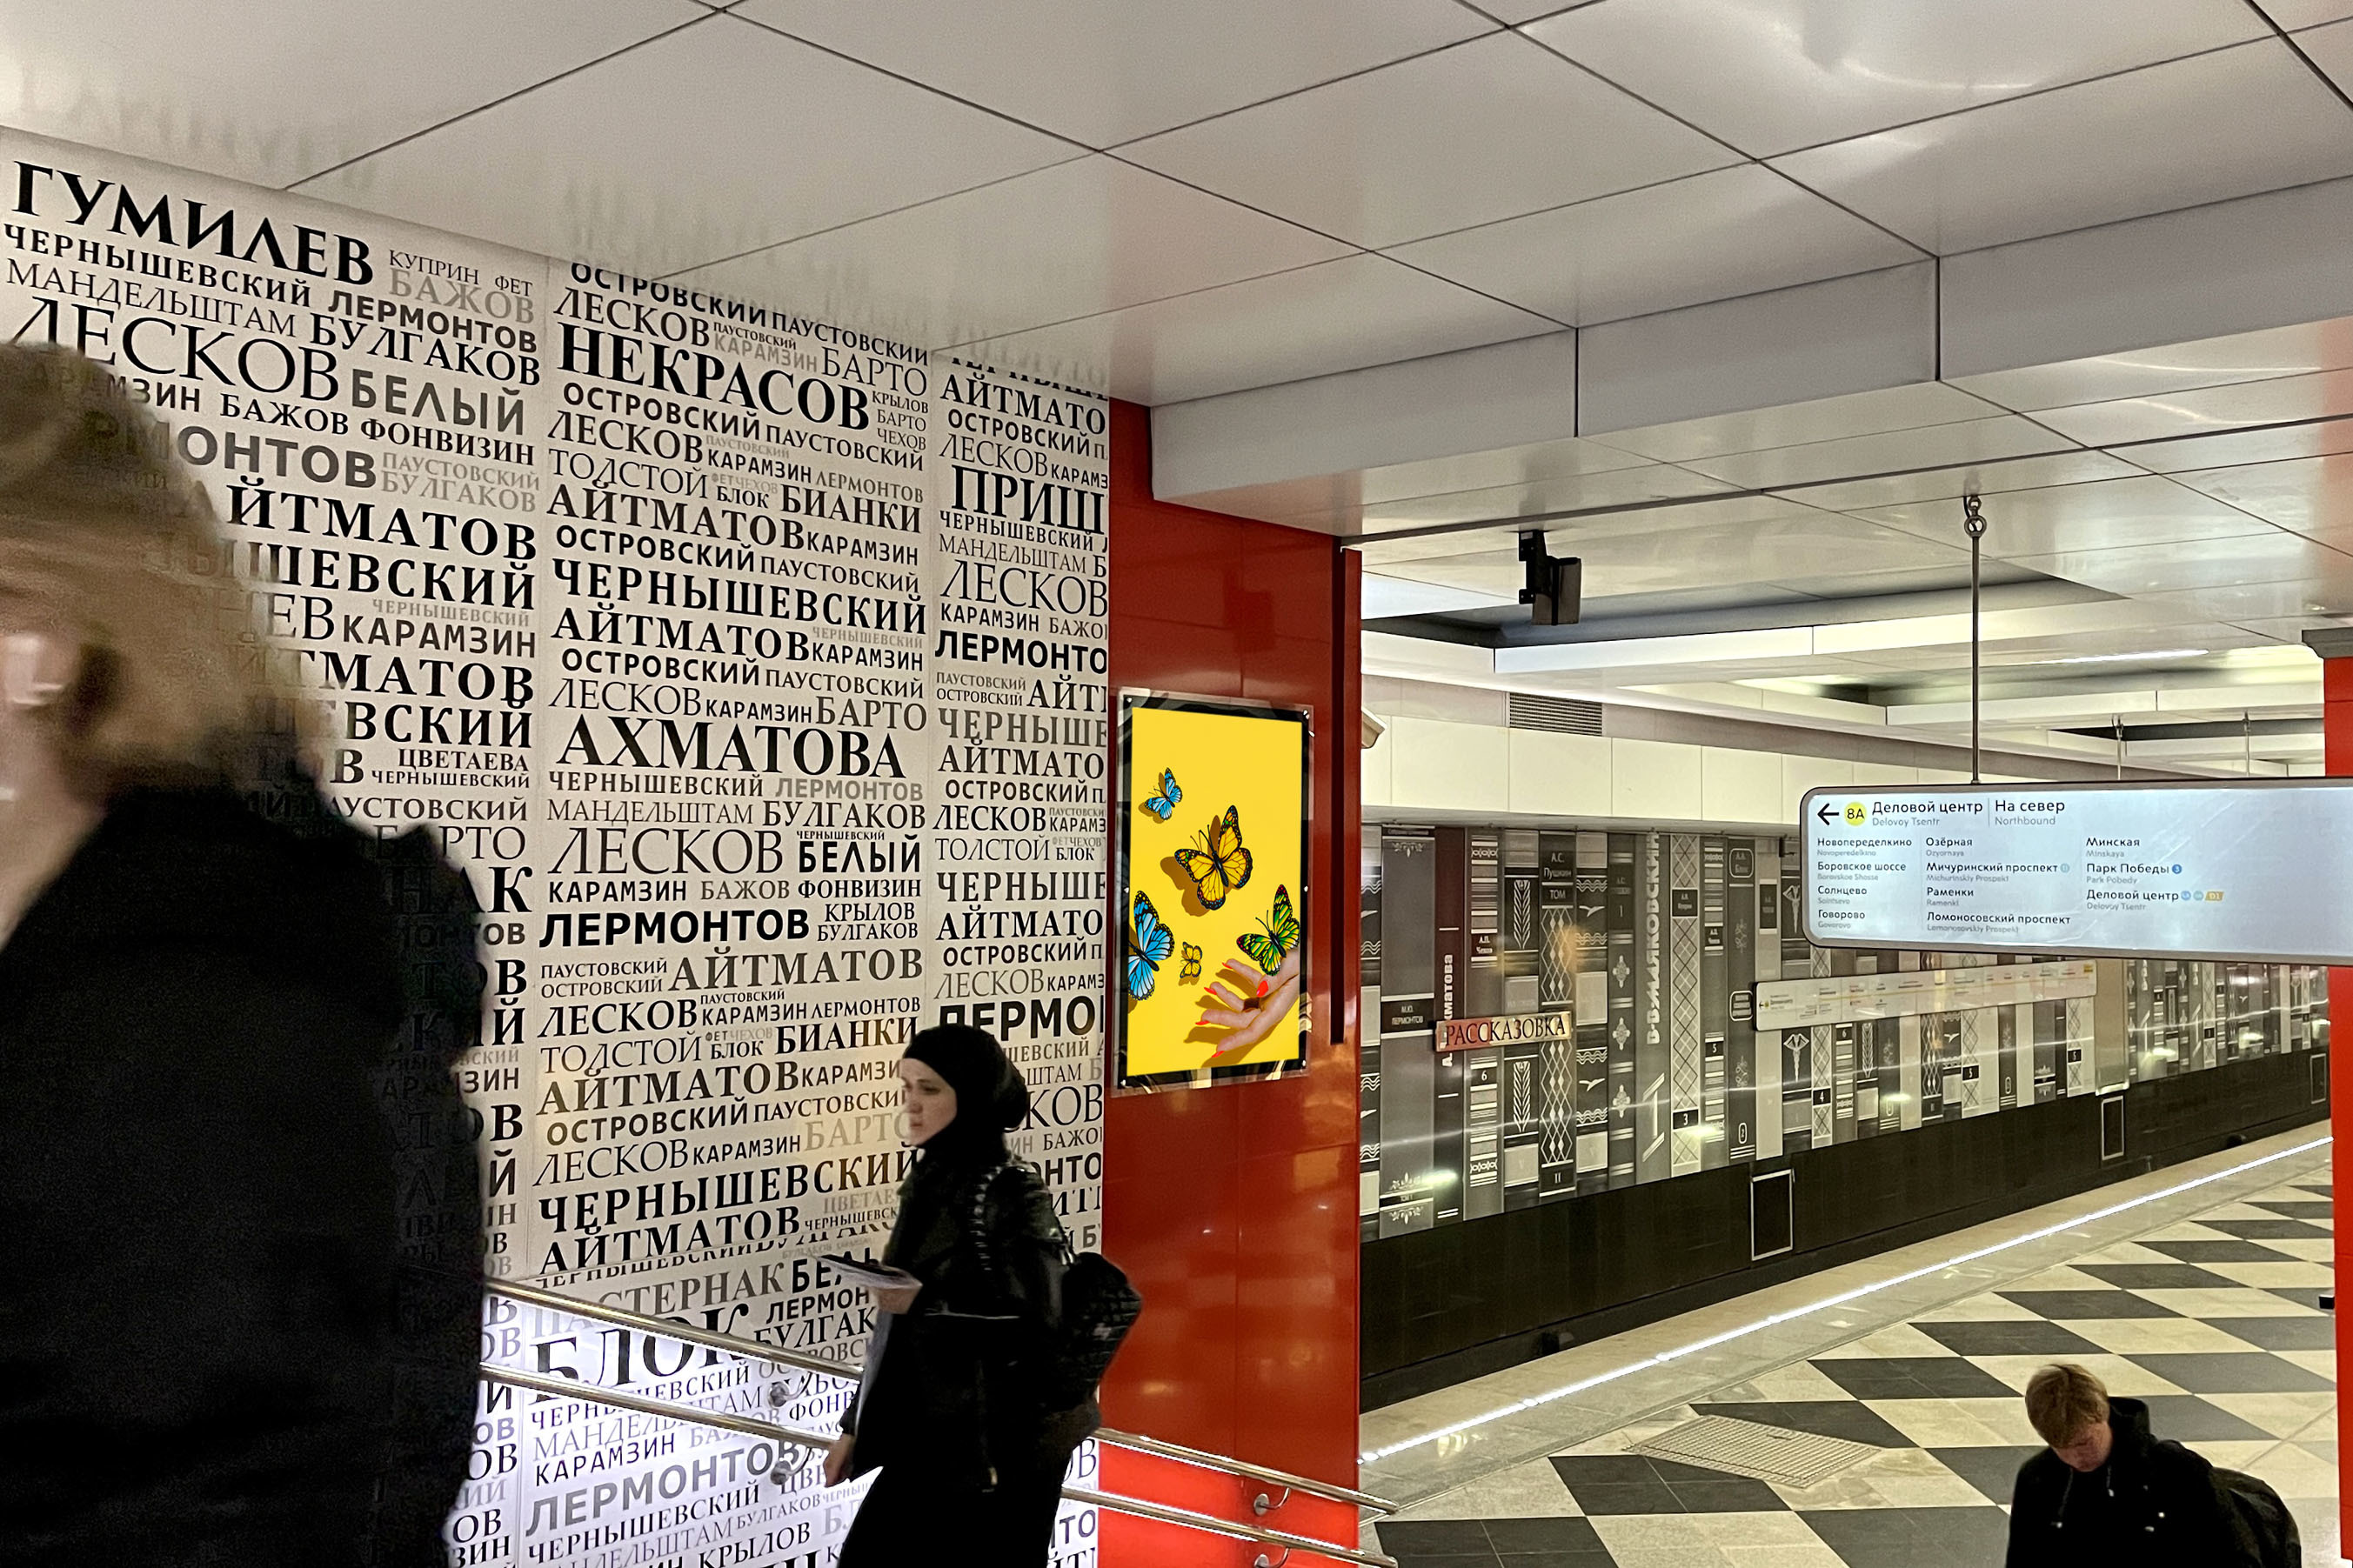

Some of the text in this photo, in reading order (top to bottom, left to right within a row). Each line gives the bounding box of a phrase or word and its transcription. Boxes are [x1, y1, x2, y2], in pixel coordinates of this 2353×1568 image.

[11, 160, 374, 285] ГУМИЛЕВ
[3, 223, 537, 353] ЧЕРНЫШЕВСКИЙ ЛЕРМОНТОВ
[388, 249, 532, 297] КУПРИН ФЕТ
[390, 270, 534, 324] БАЖОВ
[6, 260, 540, 387] МАНДЕЛЬШТАМ БУЛГАКОВ
[553, 287, 797, 350] ЛЕСКОВ ПАУСТОВСКИЙ
[558, 322, 929, 431] НЕКРАСОВ КРЫЛОВ
[714, 332, 818, 373] КАРАМЗИН
[821, 345, 927, 397] БАРТО
[351, 369, 524, 435] БЕЛЫЙ
[877, 409, 926, 432] БАРТО
[220, 392, 350, 436] БАЖОВ
[360, 417, 534, 466] ФОНВИЗИН
[548, 410, 790, 464] ЛЕСКОВ ПАУСТОВСКИЙ
[563, 382, 924, 472] ОСТРОВСКИЙ ПАУСТОВСКИЙ
[877, 429, 926, 451] ЧЕХОВ
[948, 409, 1090, 457] ОСТРОВСКИЙ
[383, 451, 539, 490] ПАУСТОВСКИЙ
[548, 447, 708, 500] ТОЛСТОЙ
[939, 433, 1047, 476] ЛЕСКОВ
[381, 470, 536, 512] БУЛГАКОВ
[707, 449, 924, 504] КАРАМЗИН ЛЕРМОНТОВ
[546, 480, 919, 567] АЙТМАТОВ КАРАМЗИН
[717, 483, 921, 535] БЛОК БИАНКИ
[940, 510, 1093, 551] ЧЕРНЫШЕВСКИЙ
[556, 524, 919, 594] ОСТРОВСКИЙ ПАУСТОВСКИЙ
[939, 533, 1086, 574] МАНДЕЛЬШТАМ
[551, 558, 926, 636] ЧЕРНЫШЕВСКИЙ
[940, 559, 1107, 617] ЛЕСКОВ
[372, 598, 530, 627] ЧЕРНЫШЕВСКИЙ
[551, 601, 923, 663] АЙТМАТОВ ЧЕРНЫШЕВСКИЙ
[941, 603, 1039, 632] КАРАМЗИН
[343, 615, 536, 658] КАРАМЗИН
[561, 647, 924, 699] ОСТРОВСКИЙ ПАУСТОВСКИЙ
[812, 643, 923, 672] КАРАМЗИН
[937, 671, 1026, 691] ПАУСТОВСКИЙ
[937, 688, 1022, 706] ОСТРОВСКИЙ
[549, 677, 927, 731] ЛЕСКОВ КАРАМЗИН БАРТО
[398, 748, 530, 772] ЦВЕТАЕВА
[556, 713, 906, 779] АХМАТОВА
[371, 770, 530, 789] ЧЕРНЫШЕВСКИЙ
[549, 771, 923, 802] ЧЕРНЫШЕВСКИЙ ЛЕРМОНТОВ
[946, 779, 1087, 803] ОСТРОВСКИЙ
[547, 798, 926, 830] МАНДЕЛЬШТАМ БУЛГАКОВ
[933, 804, 1046, 831] ЛЕСКОВ
[1872, 801, 1935, 816] Деловой
[1940, 804, 1983, 816] центр
[1995, 800, 2015, 811] На
[2020, 802, 2065, 815] север
[1872, 816, 2056, 827] Delovoy Tsentr Northbound
[547, 826, 920, 875] ЛЕСКОВ БЕЛЫЙ
[797, 830, 885, 841] ЧЕРНЫШЕВСКИЙ
[935, 835, 1050, 860] ТОЛСТОЙ
[1056, 847, 1094, 860] БЛОК
[1817, 837, 2140, 847] Новопеределкино Озёрная Минская
[2086, 850, 2124, 858] Minskaya
[1817, 861, 1872, 871] Боровское
[1926, 862, 2003, 873] Мичуринский
[2005, 864, 2058, 873] проспект
[2087, 864, 2116, 875] Парк
[2121, 863, 2169, 875] Победы
[549, 880, 687, 904] КАРАМЗИН
[700, 879, 790, 901] БАЖОВ
[798, 878, 921, 899] ФОНВИЗИН
[1550, 890, 1566, 899] ТОМ
[1817, 885, 1868, 895] Солнцево
[1927, 887, 1974, 897] Раменки
[2087, 890, 2139, 900] Деловой
[2143, 892, 2179, 903] центр
[539, 909, 810, 949] ЛЕРМОНТОВ
[825, 902, 915, 923] КРЫЛОВ
[818, 922, 919, 943] БУЛГАКОВ
[1818, 910, 2070, 924] Говорово Ломоносовский проспект
[541, 957, 668, 979] ПАУСТОВСКИЙ
[669, 947, 922, 992] АЙТМАТОВ
[943, 937, 1086, 966] ОСТРОВСКИЙ
[541, 976, 663, 999] ОСТРОВСКИЙ
[700, 989, 785, 1005] ПАУСТОВСКИЙ
[934, 968, 1044, 999] ЛЕСКОВ
[537, 998, 698, 1038] ЛЕСКОВ
[702, 1003, 807, 1027] КАРАМЗИН
[812, 997, 921, 1018] ЛЕРМОНТОВ
[710, 1016, 919, 1060] БЛОК БИАНКИ
[1446, 1015, 1566, 1047] РАССКАЗОВКА
[540, 1030, 702, 1074] ТОЛСТОЙ
[705, 1030, 728, 1043] ФЕТ
[1712, 1044, 1718, 1052] 5
[536, 1059, 799, 1117] АЙТМАТОВ
[1481, 1071, 1487, 1081] 6
[546, 1096, 748, 1146] ОСТРОВСКИЙ
[1683, 1113, 1688, 1125] 3
[533, 1134, 801, 1187] ЛЕСКОВ КАРАМЗИН
[540, 1206, 799, 1275] АЙТМАТОВ
[536, 1432, 675, 1486] КАРАМЗИН
[528, 1482, 759, 1565] ЧЕРНЫШЕВСКИЙ
[737, 1493, 820, 1531] БУЛГАКОВ
[698, 1521, 811, 1568] КРЫЛОВ
